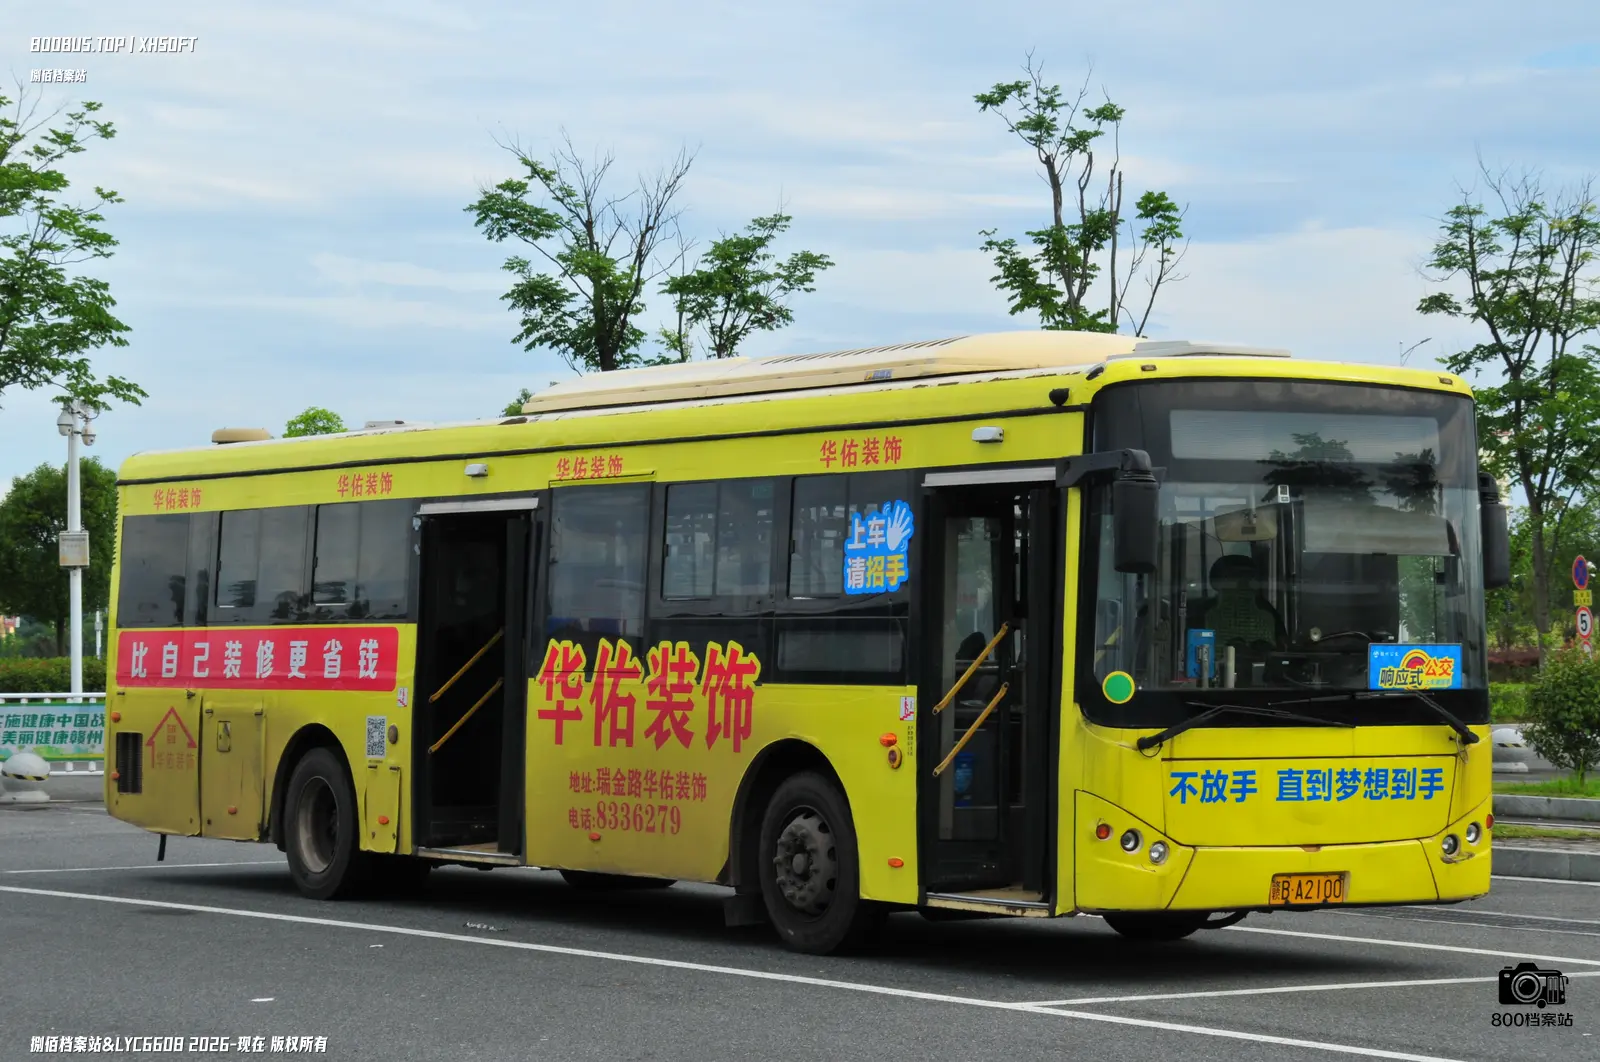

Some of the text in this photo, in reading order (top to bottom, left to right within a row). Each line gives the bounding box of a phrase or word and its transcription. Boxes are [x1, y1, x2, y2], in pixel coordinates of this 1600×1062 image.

[820, 436, 903, 468] 华佑装饰
[556, 454, 624, 481] 华佑装饰
[153, 488, 203, 511] 华佑装饰
[337, 471, 394, 498] 华佑装饰
[847, 517, 886, 550] 上车
[846, 554, 905, 590] 请招手
[1580, 613, 1588, 632] 5
[130, 638, 380, 681] 比自己装修更省钱
[1380, 658, 1454, 686] 响应式 公交
[537, 643, 758, 754] 华佑装饰
[0, 713, 105, 729] 施健康中国战
[2, 729, 104, 745] 美丽健康赣州
[1169, 767, 1445, 805] 不放手 直到梦想到手
[568, 800, 682, 835] 电话:8336279
